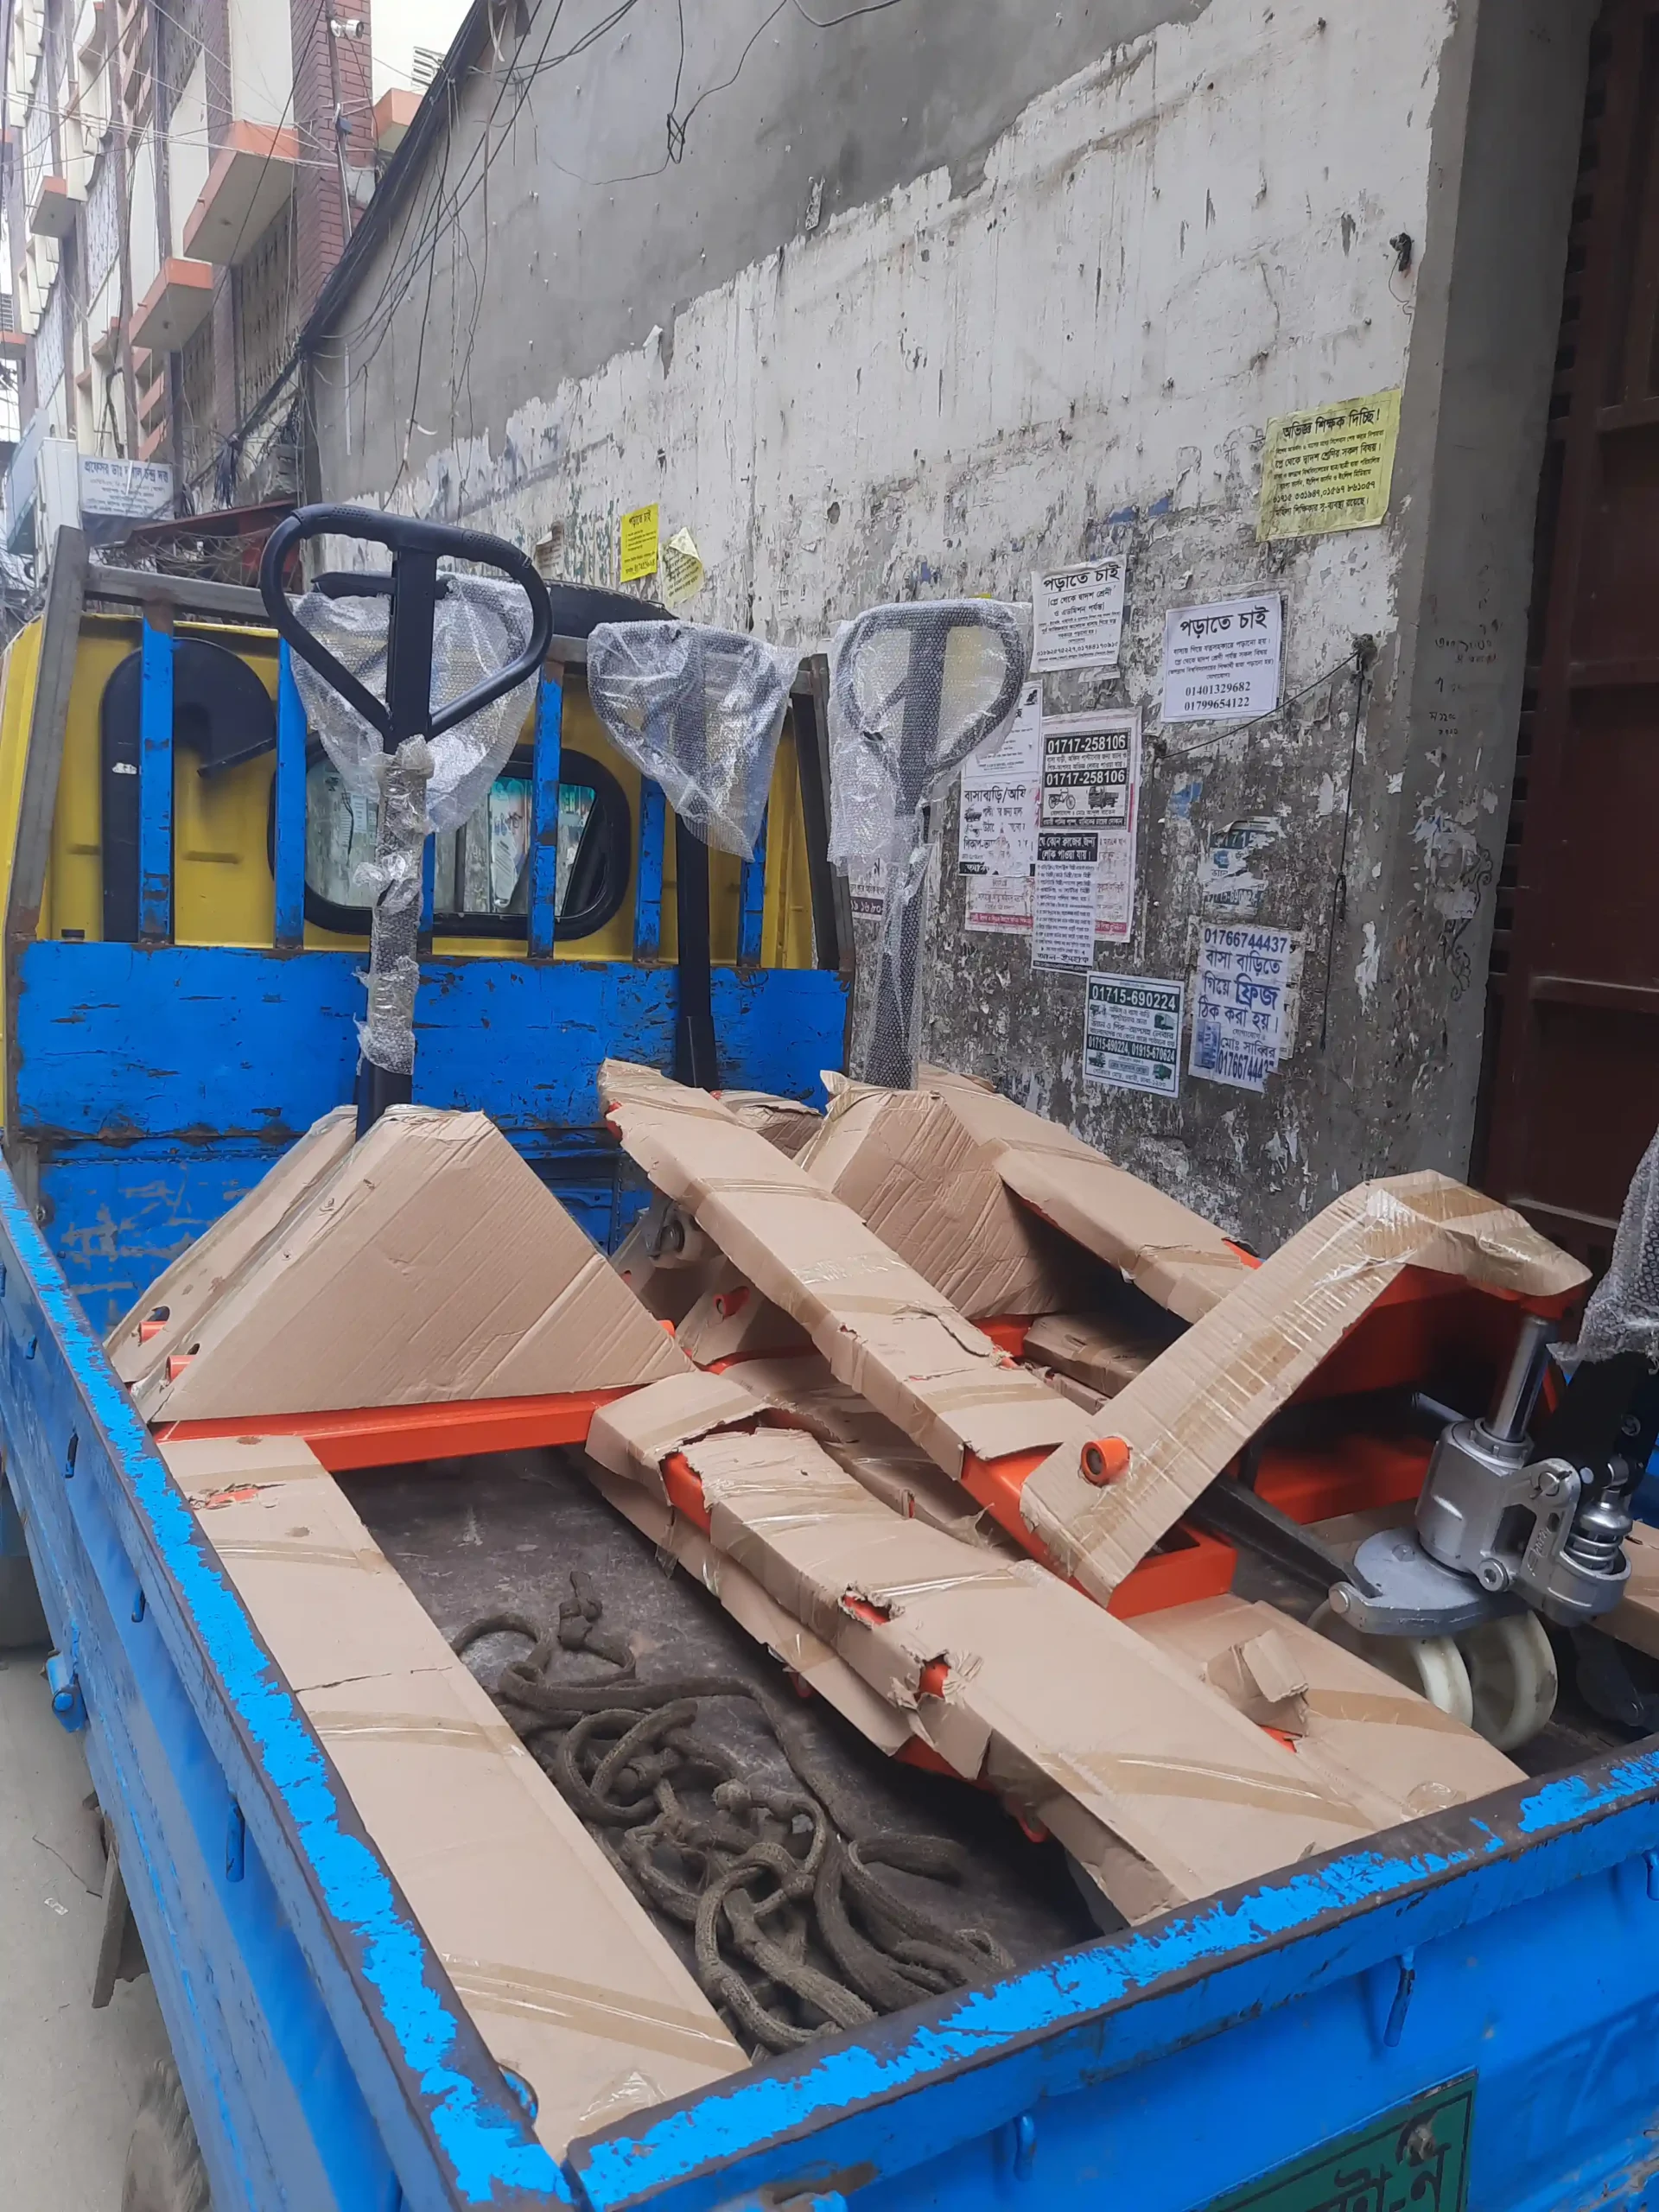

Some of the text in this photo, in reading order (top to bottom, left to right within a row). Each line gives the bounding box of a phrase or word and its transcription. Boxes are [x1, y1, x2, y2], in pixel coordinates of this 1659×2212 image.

[1315, 416, 1345, 434] শিক্ষক
[1285, 456, 1301, 466] থেকে
[1342, 446, 1358, 456] সকল
[1044, 563, 1122, 592] পড়াতে চাই
[1180, 605, 1270, 639] পড়াতে চাই
[1185, 682, 1251, 696] 01401329682
[1185, 696, 1249, 711] 01799654122
[1047, 734, 1126, 753] 01717-258106
[1046, 770, 1125, 785] 01717-258106
[1042, 848, 1057, 860] লোক
[1058, 849, 1076, 860] পাওয়া
[1204, 928, 1287, 953] 01766744437
[1205, 949, 1283, 976] বাসা বাড়িতে
[1092, 986, 1176, 1010] 01715-690224
[1202, 970, 1281, 1010] গিয়ে ফ্রিজ
[1198, 995, 1221, 1020] ঠিক
[1224, 1007, 1249, 1027] করা
[1088, 1036, 1175, 1062] 01715-690224, 01915-670624
[1220, 1037, 1276, 1058] মোঃ সাব্বির
